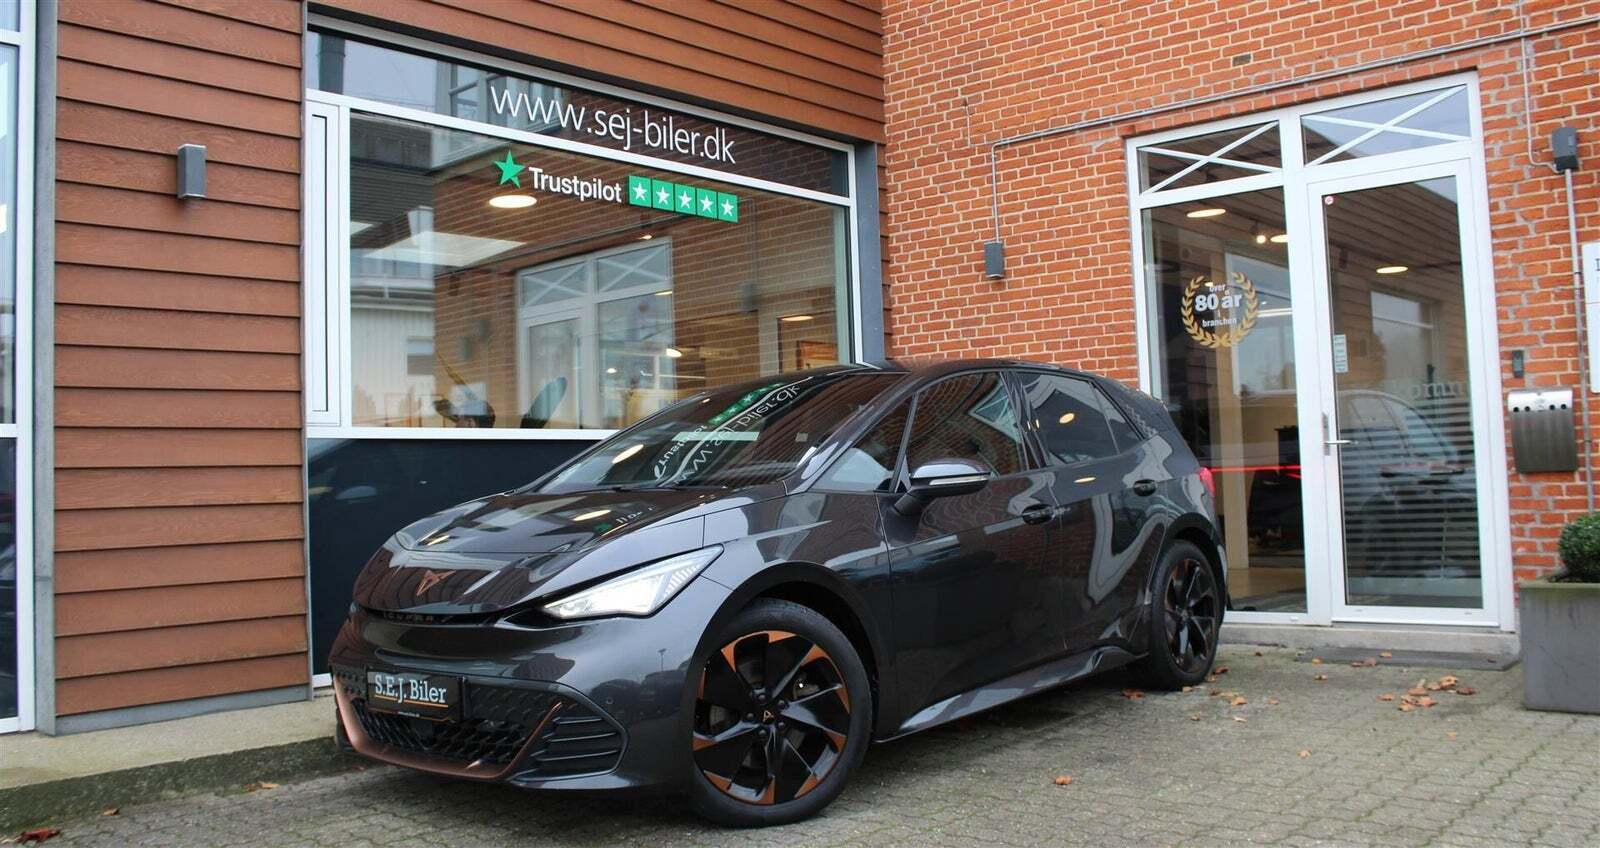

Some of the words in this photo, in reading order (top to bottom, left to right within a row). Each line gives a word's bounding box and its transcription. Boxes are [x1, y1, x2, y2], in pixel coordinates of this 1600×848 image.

[490, 85, 736, 164] www.sej-biler.dk
[528, 167, 622, 203] Trustpilot
[1195, 293, 1219, 311] 80
[1222, 289, 1242, 309] år
[1202, 318, 1237, 328] branchen
[374, 674, 406, 703] S.E.J.
[410, 679, 447, 703] Biler
